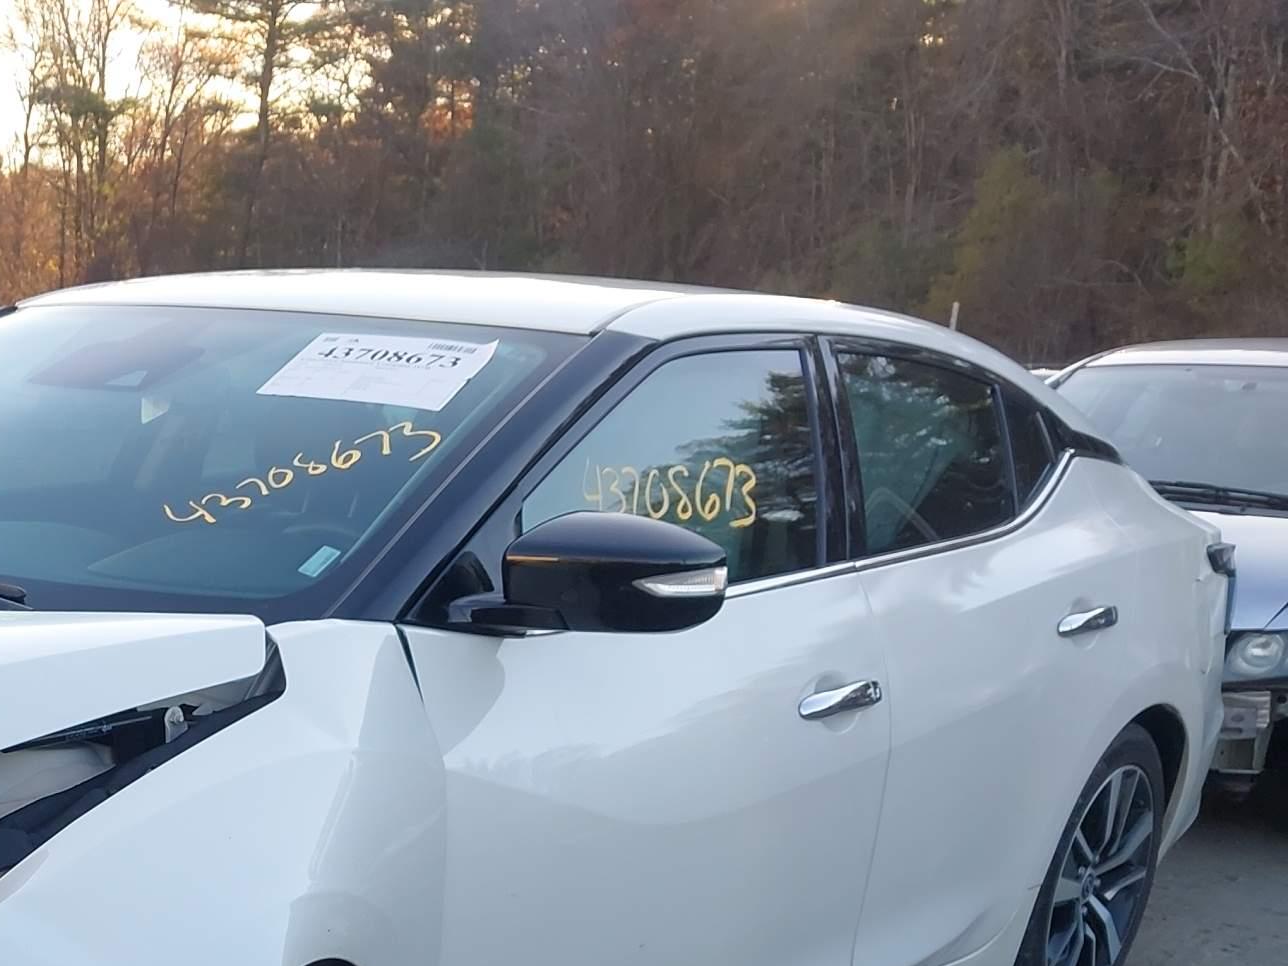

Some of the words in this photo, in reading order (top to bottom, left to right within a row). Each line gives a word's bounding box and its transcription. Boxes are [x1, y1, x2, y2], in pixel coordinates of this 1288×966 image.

[317, 346, 462, 368] 43708673
[163, 421, 441, 523] 43708673
[582, 456, 757, 528] 43708673
